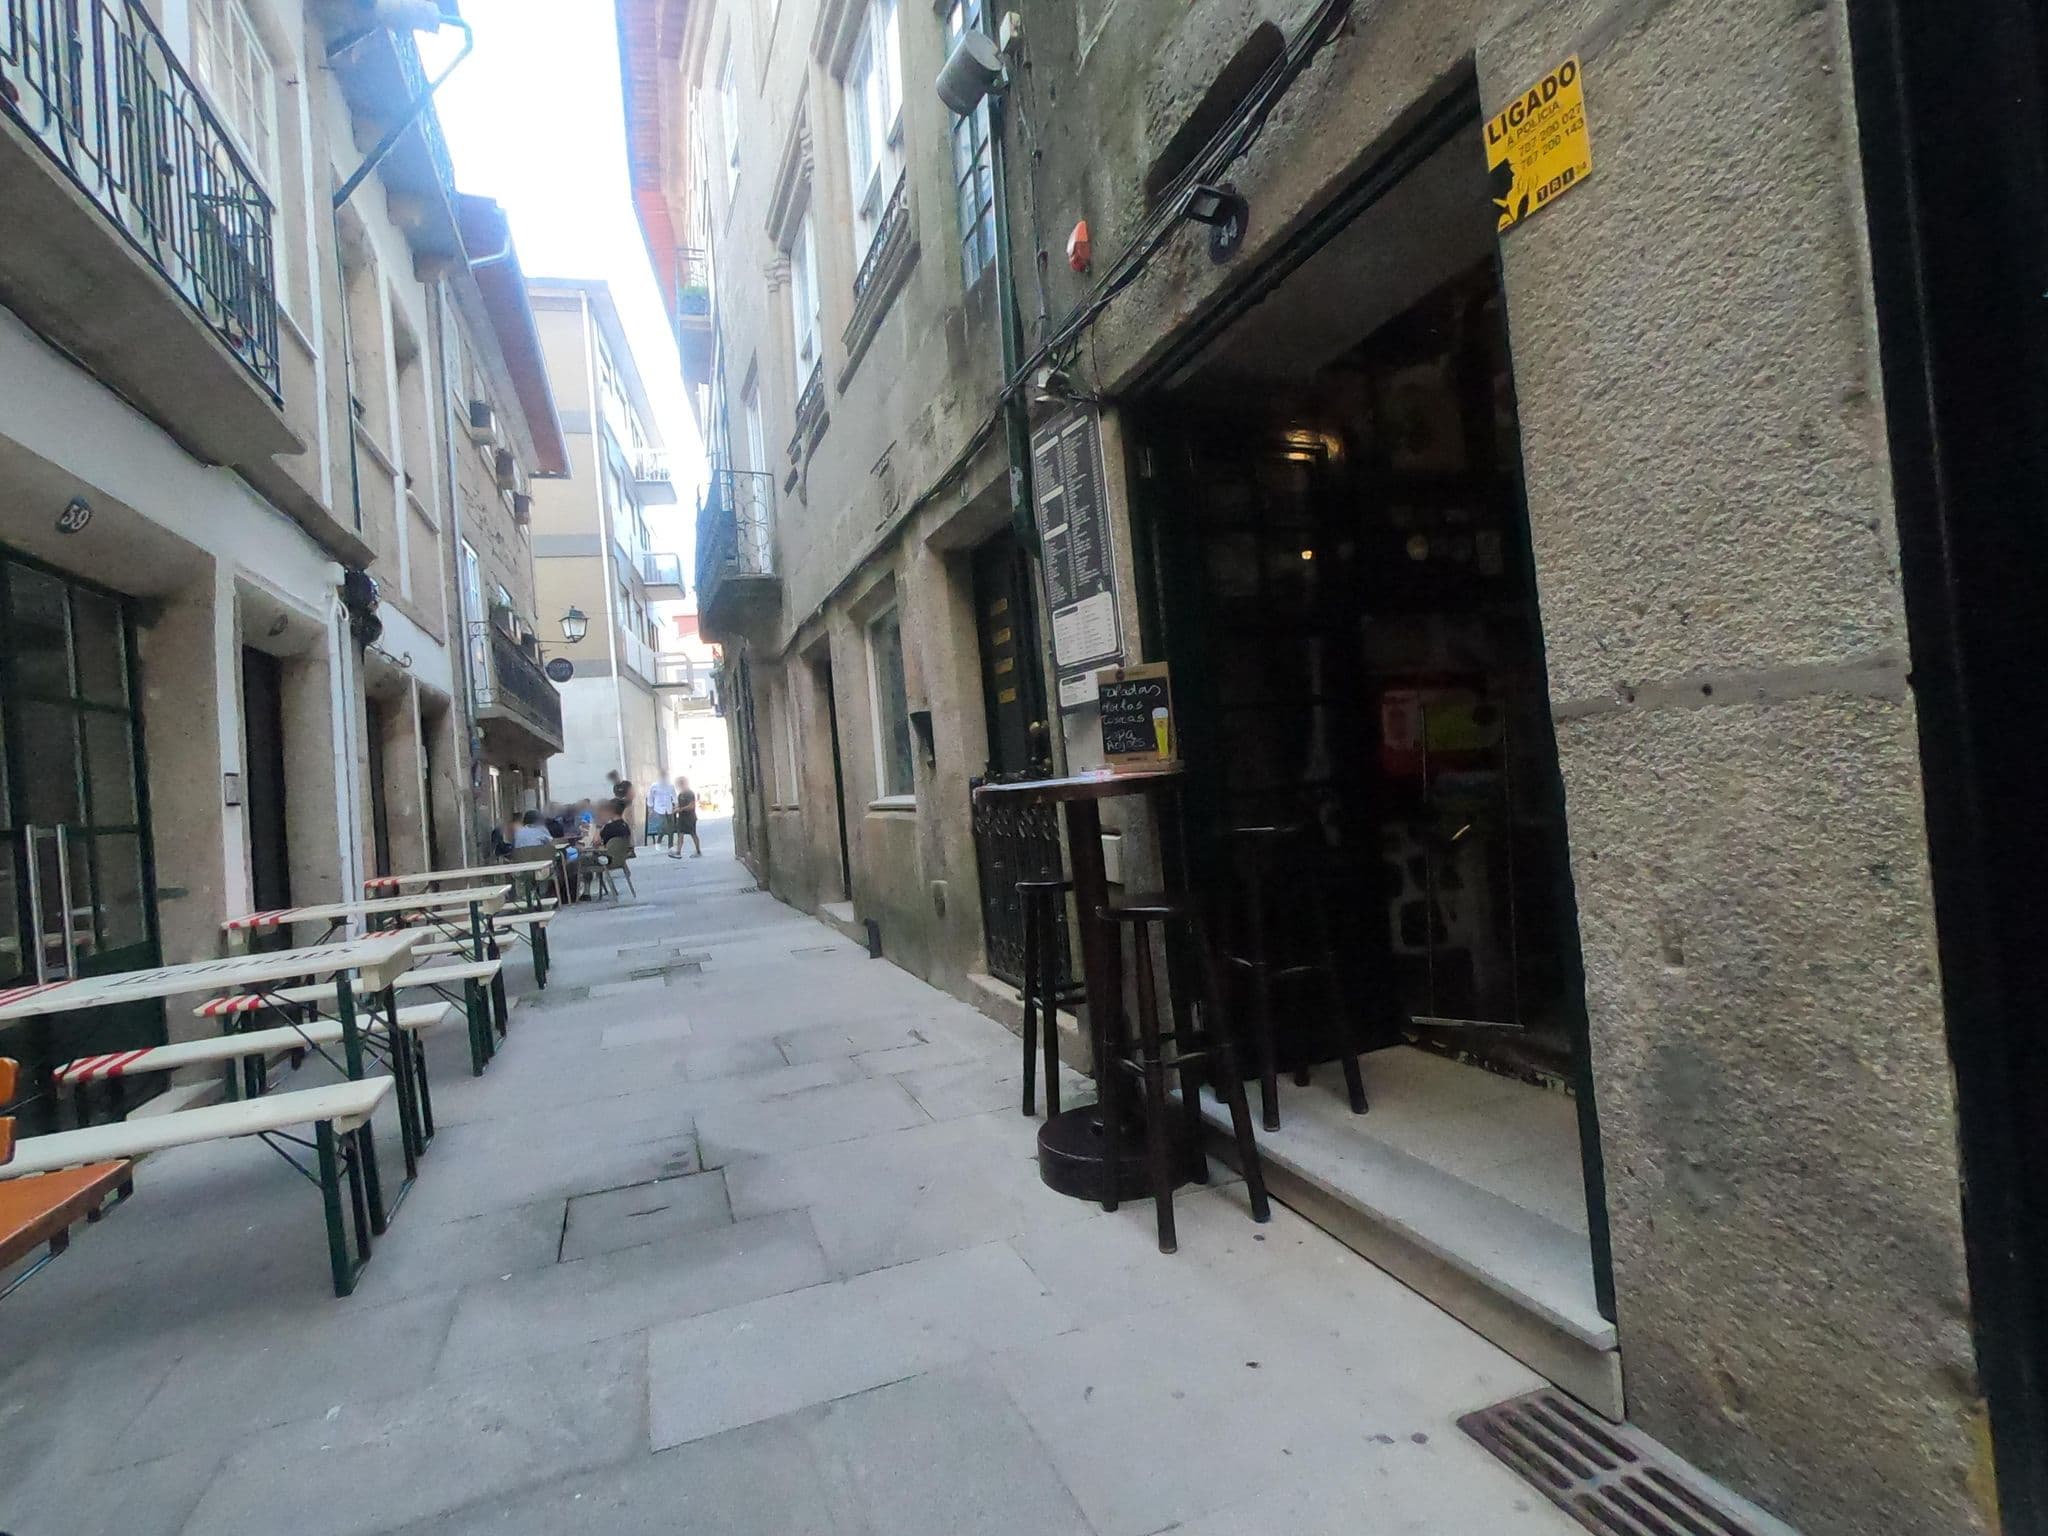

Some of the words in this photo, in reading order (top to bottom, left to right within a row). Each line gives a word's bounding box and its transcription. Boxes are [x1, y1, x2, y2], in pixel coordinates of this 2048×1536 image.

[1487, 61, 1576, 145] LIGADO
[1561, 102, 1583, 125] 027
[60, 503, 90, 530] 59
